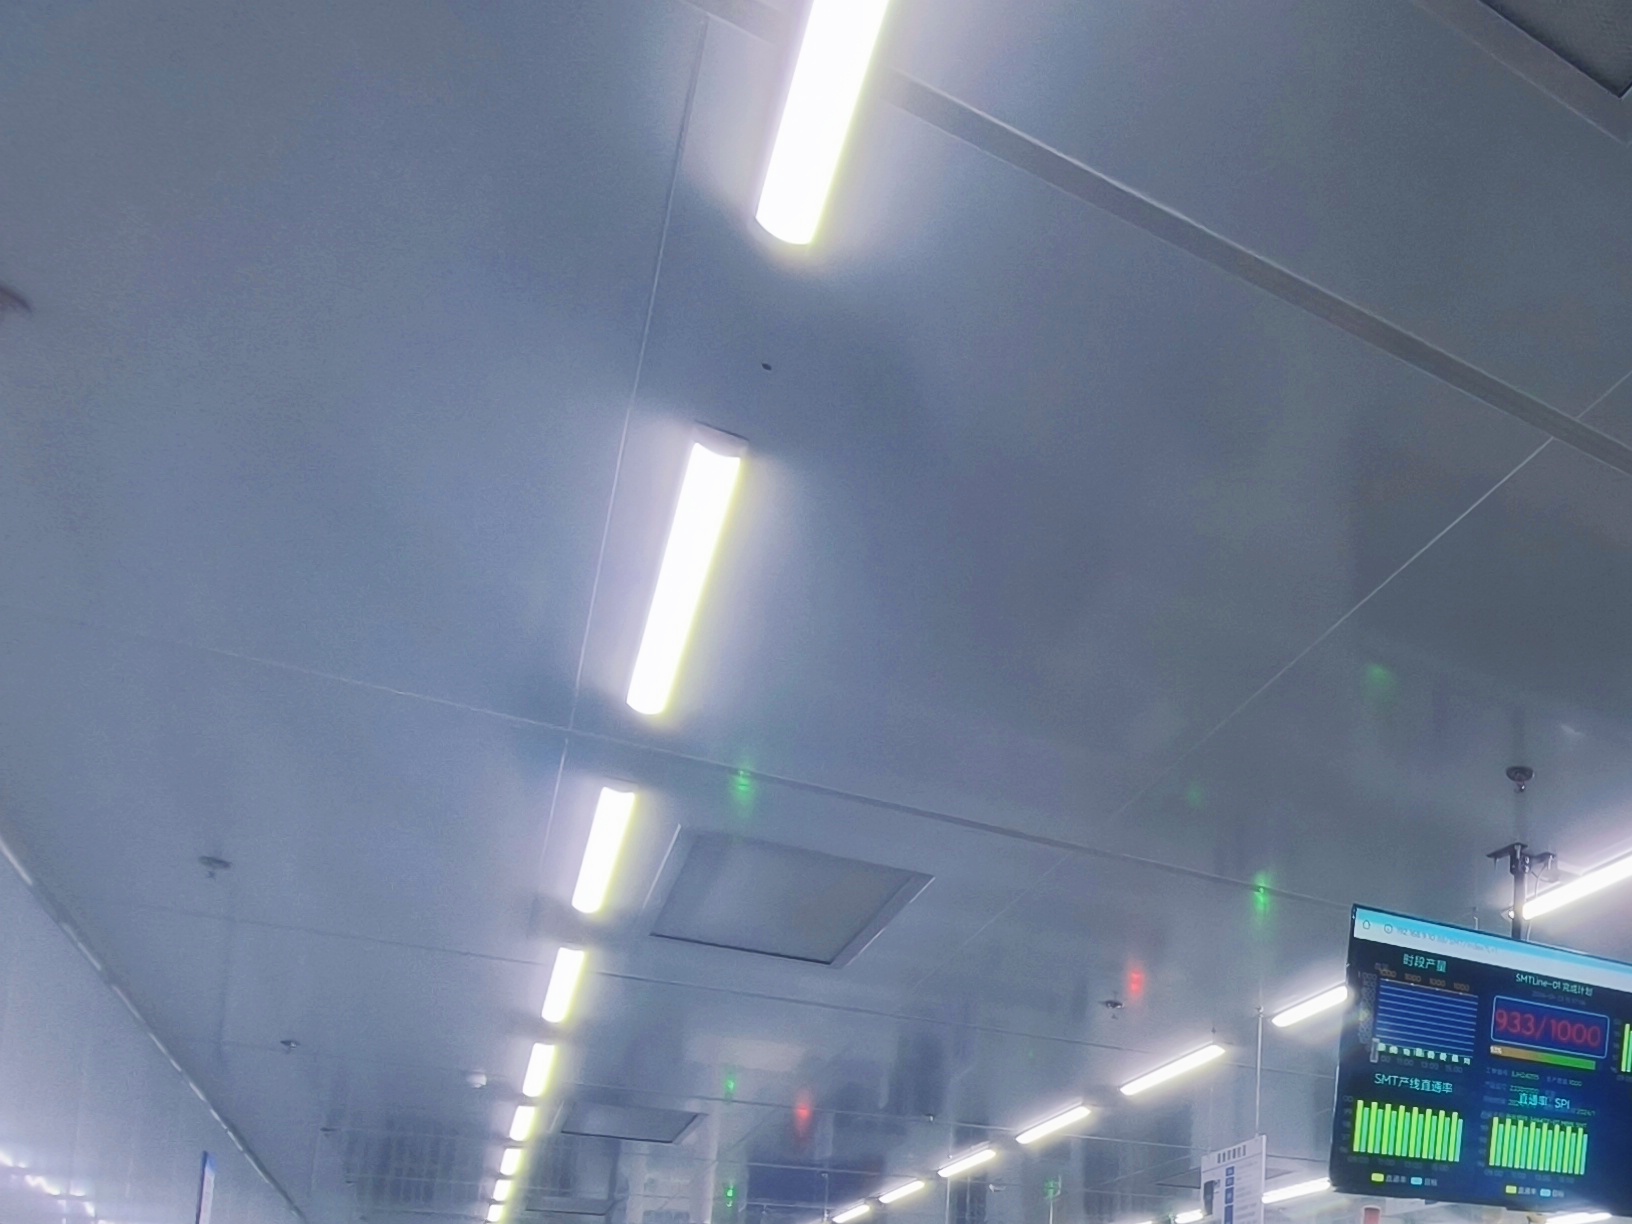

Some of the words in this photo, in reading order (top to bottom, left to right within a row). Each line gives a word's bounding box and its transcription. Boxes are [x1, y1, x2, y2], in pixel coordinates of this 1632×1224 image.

[1403, 953, 1446, 973] 时段产量
[1496, 1009, 1601, 1047] 933/1000
[1555, 1098, 1570, 1109] SPI
